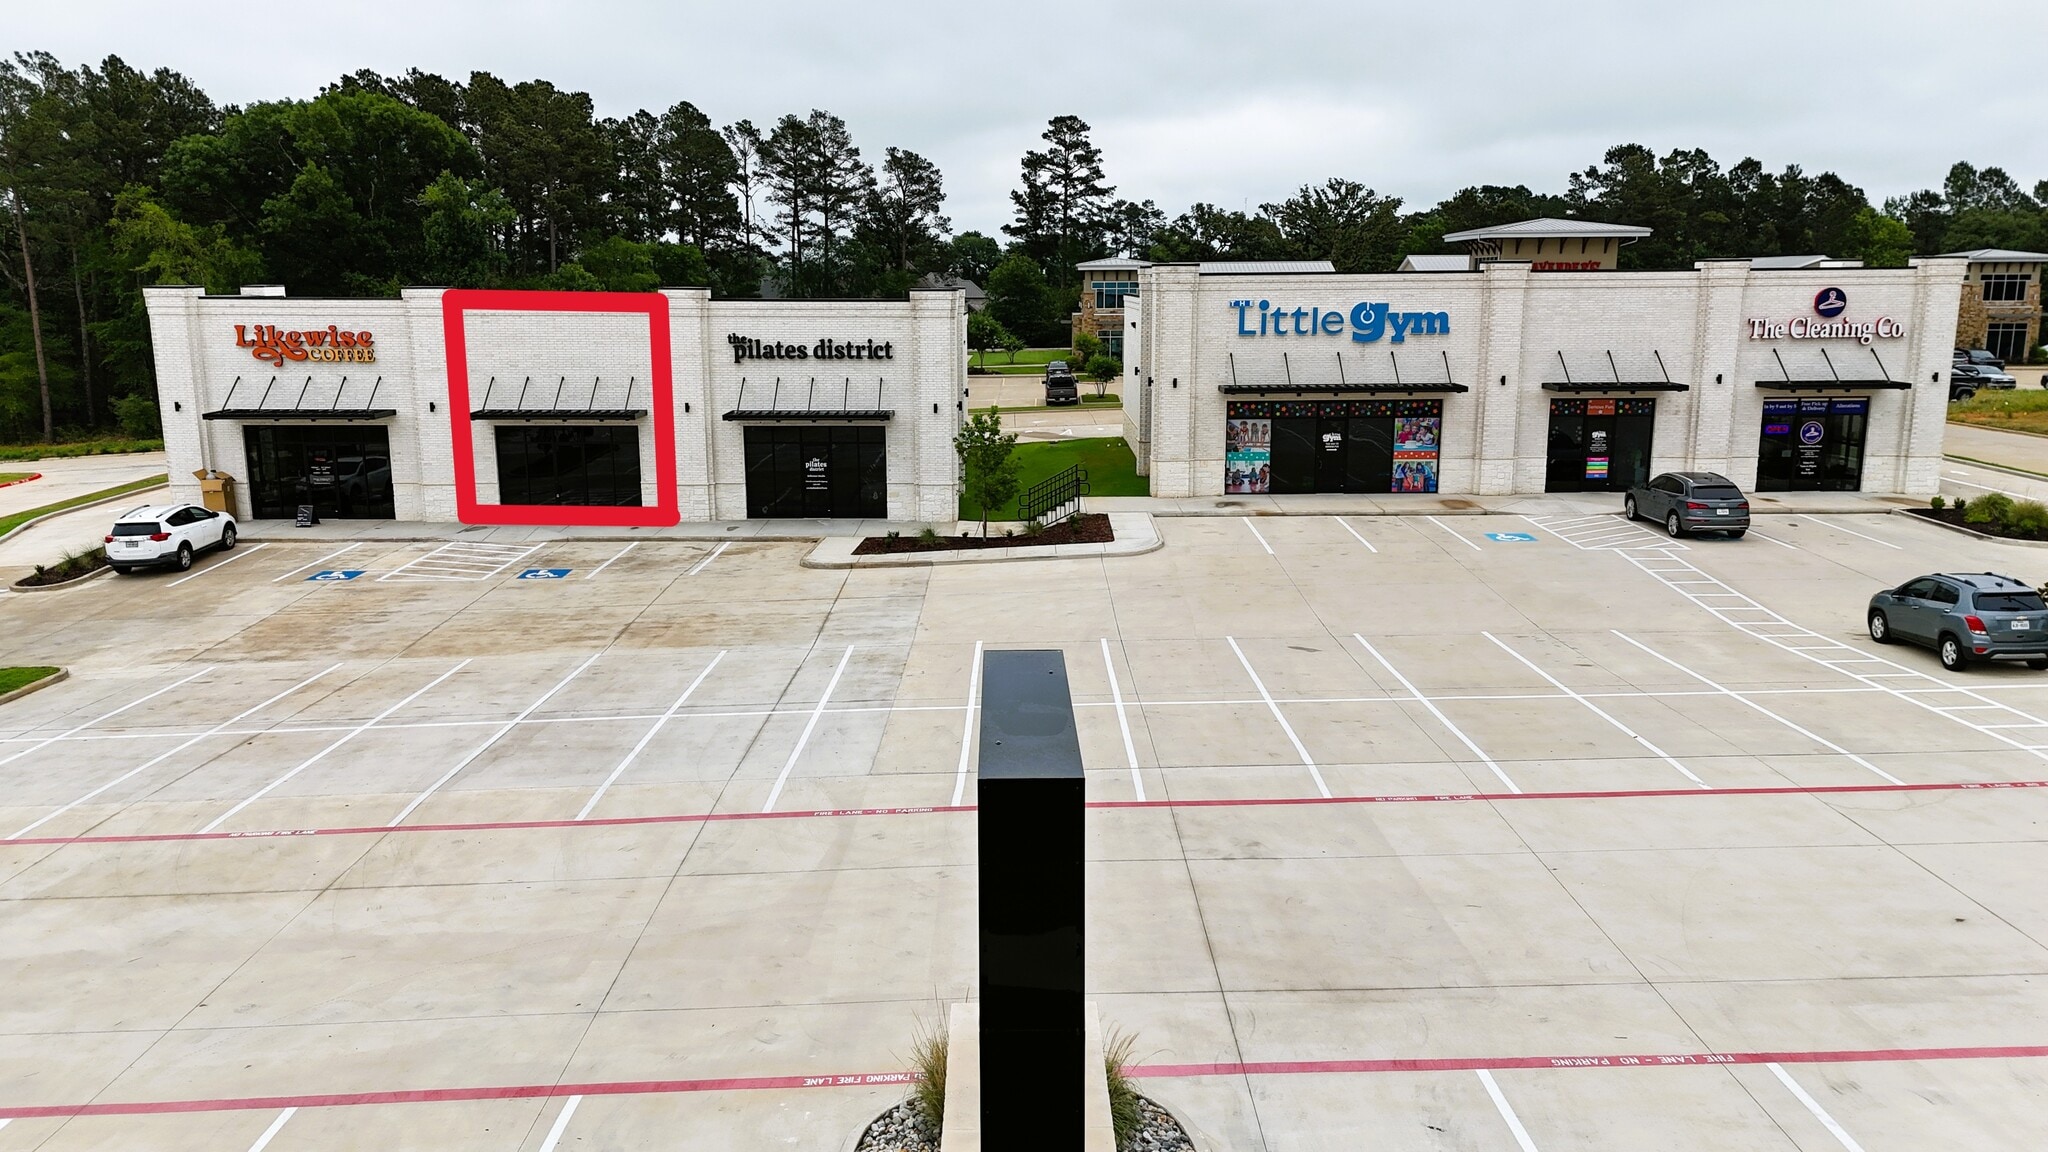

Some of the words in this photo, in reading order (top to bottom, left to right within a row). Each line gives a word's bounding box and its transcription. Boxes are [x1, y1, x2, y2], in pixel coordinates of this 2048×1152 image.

[1532, 261, 1601, 271] AVENDER'S
[1238, 300, 1345, 337] Little
[1350, 301, 1450, 343] gym
[1749, 317, 1784, 339] The
[1790, 317, 1874, 345] Cleaning
[1877, 316, 1907, 338] Co.
[727, 332, 748, 345] the
[234, 325, 375, 367] Likewise
[733, 338, 809, 364] pilates
[813, 338, 893, 360] district
[308, 348, 376, 362] COFFEE
[805, 461, 827, 469] pilates
[1551, 1057, 1610, 1066] PARKING
[1619, 1056, 1640, 1065] NO
[1658, 1055, 1695, 1064] LANE
[1705, 1054, 1735, 1063] FIRE
[803, 1078, 832, 1086] LANE
[836, 1076, 861, 1084] FIRE
[866, 1073, 910, 1083] PARKING
